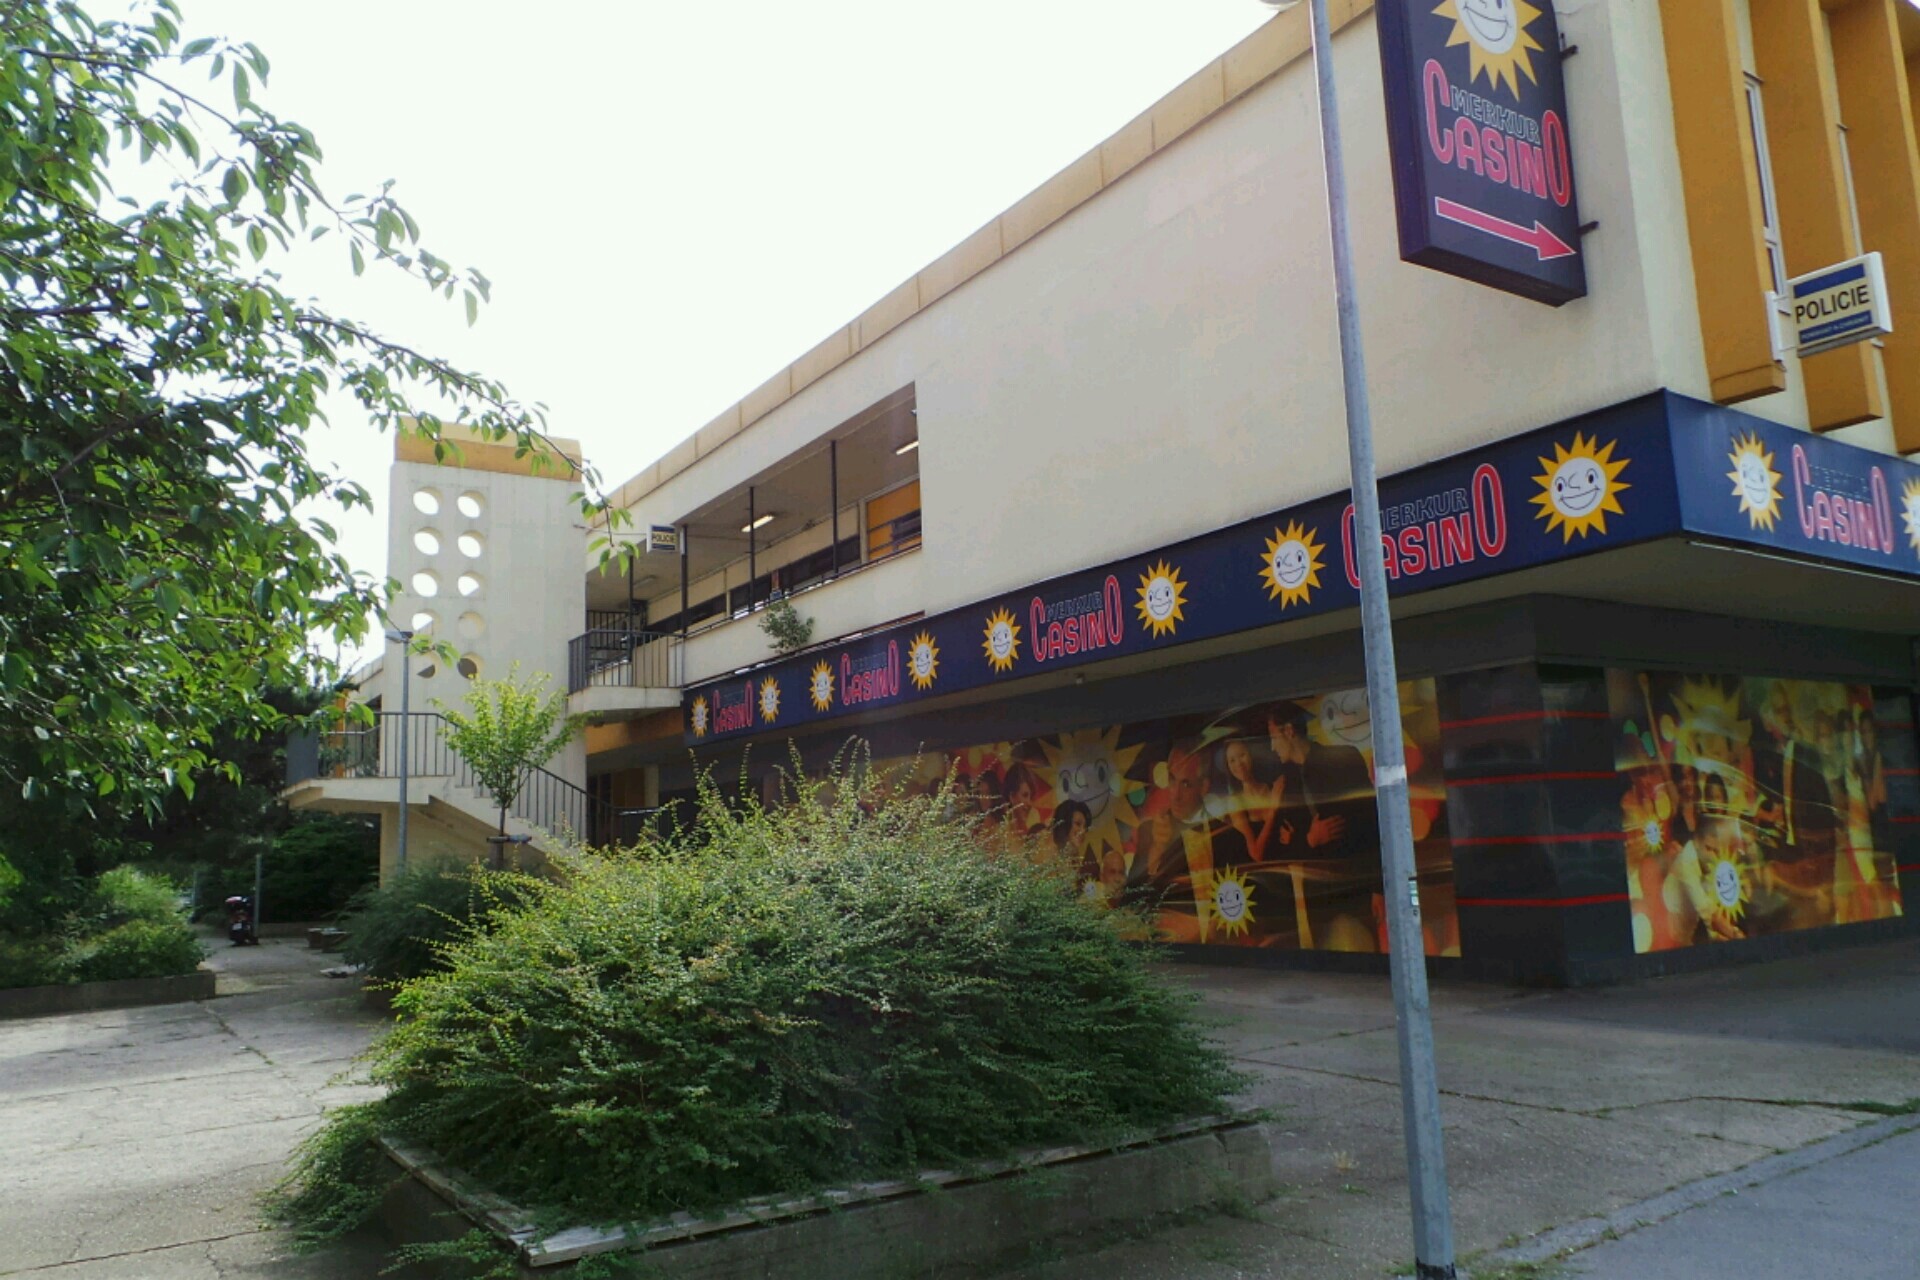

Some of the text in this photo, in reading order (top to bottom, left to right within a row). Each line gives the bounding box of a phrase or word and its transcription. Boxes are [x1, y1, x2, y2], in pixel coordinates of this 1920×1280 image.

[1423, 59, 1571, 207] CASINO
[1450, 84, 1541, 146] MERKUR
[1795, 285, 1870, 324] POLICIE
[1793, 443, 1894, 555] CASINO
[1030, 574, 1124, 663] CASINO
[840, 639, 900, 706] CASINO
[712, 678, 753, 735] CASINO
